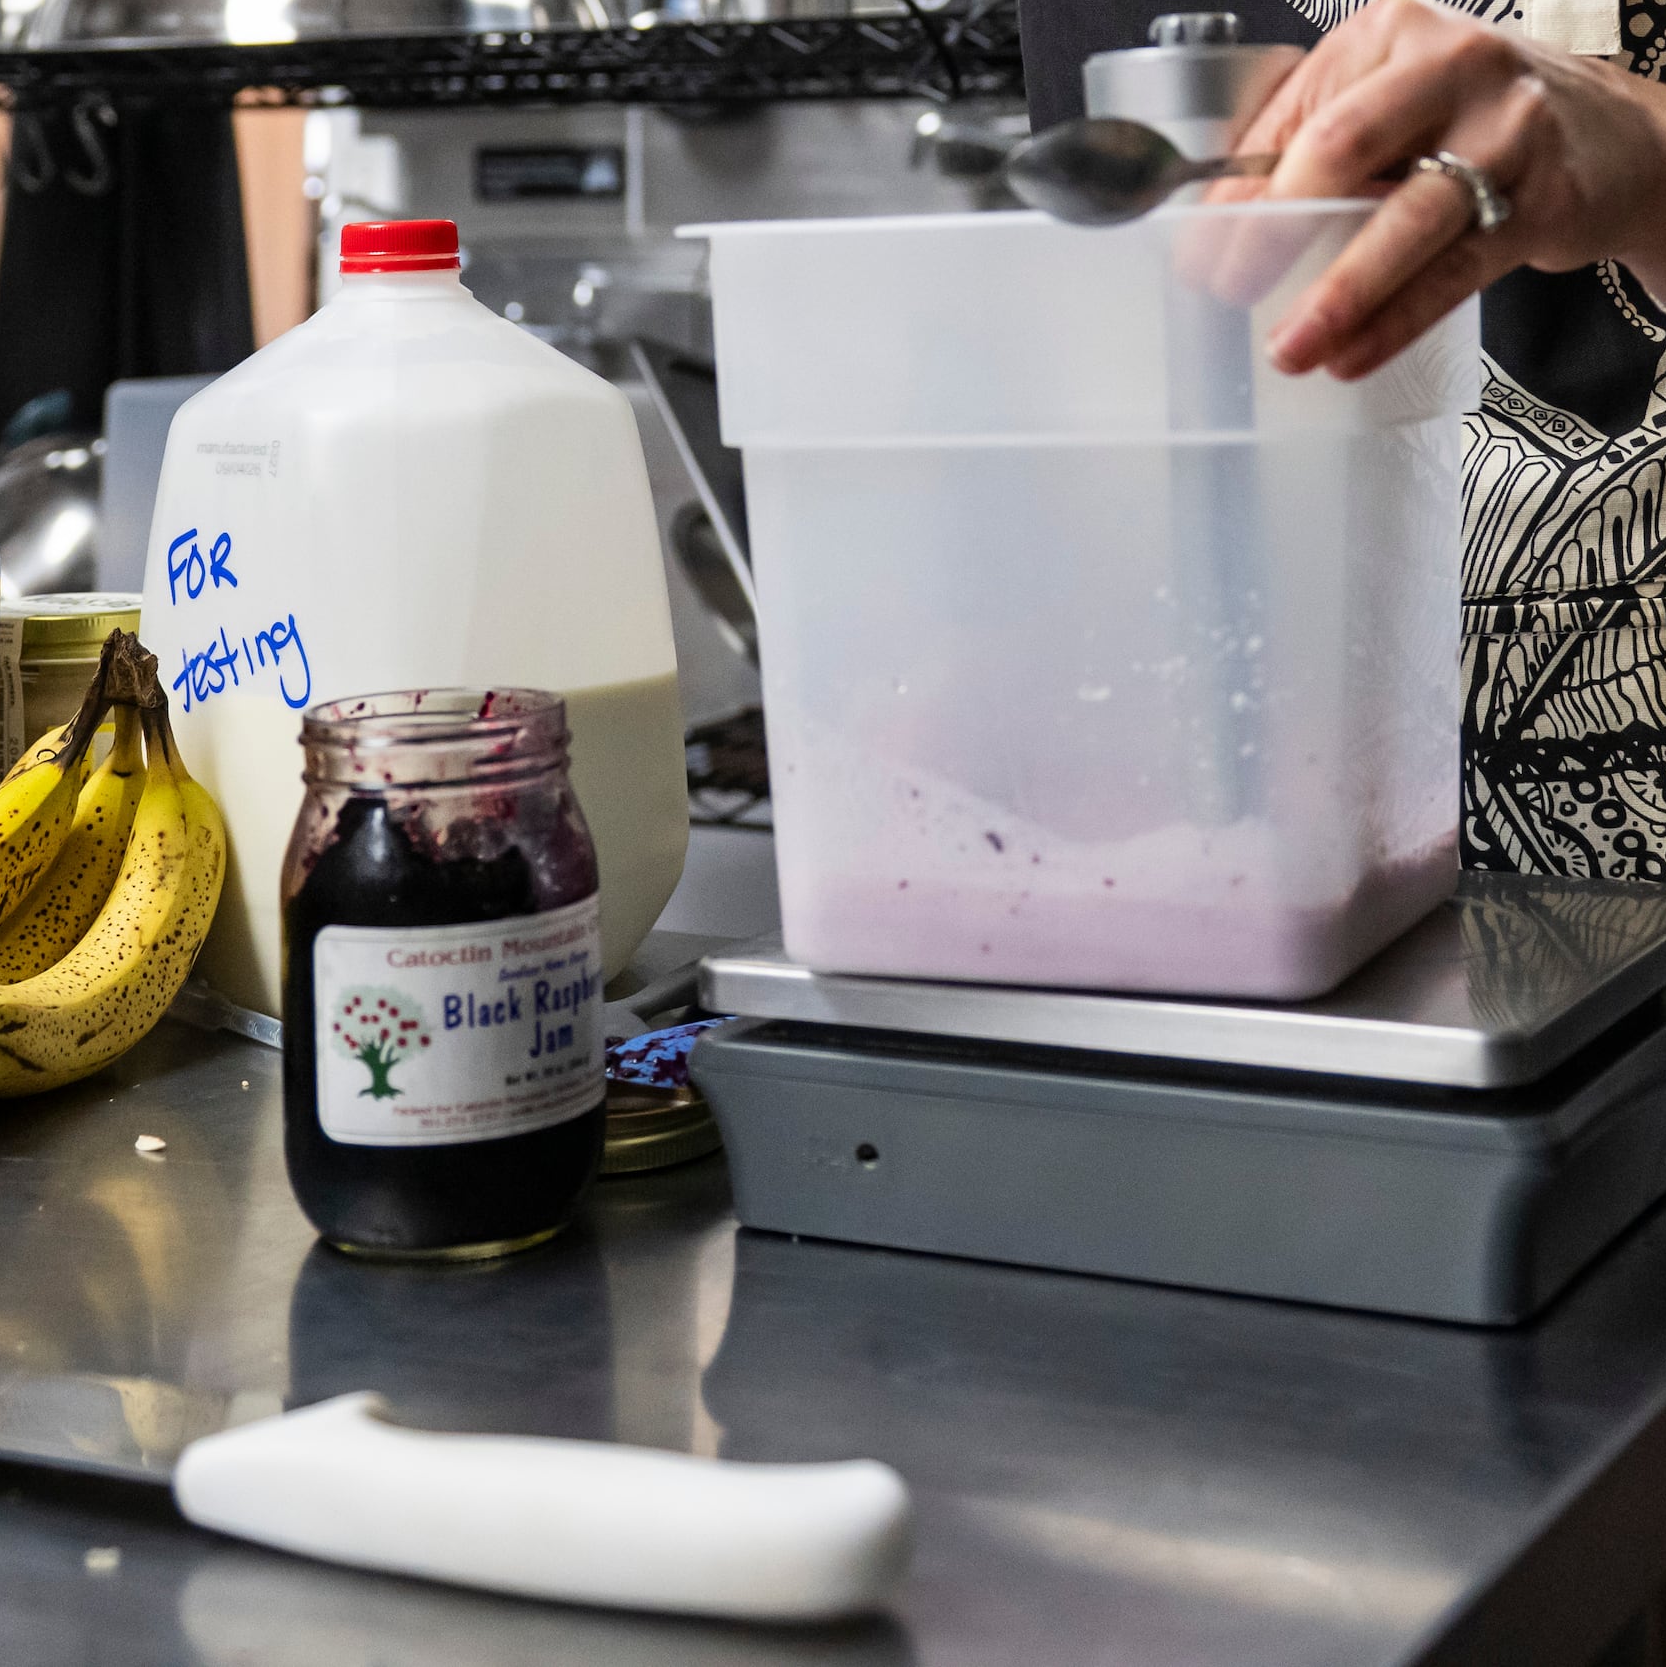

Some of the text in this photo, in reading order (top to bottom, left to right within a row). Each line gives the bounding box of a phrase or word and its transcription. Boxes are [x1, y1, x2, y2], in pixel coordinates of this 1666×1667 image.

[168, 528, 238, 605] FOR
[173, 614, 311, 713] testing
[386, 945, 492, 969] Catoctin
[443, 987, 521, 1031] Black
[529, 1021, 574, 1058] Jam
